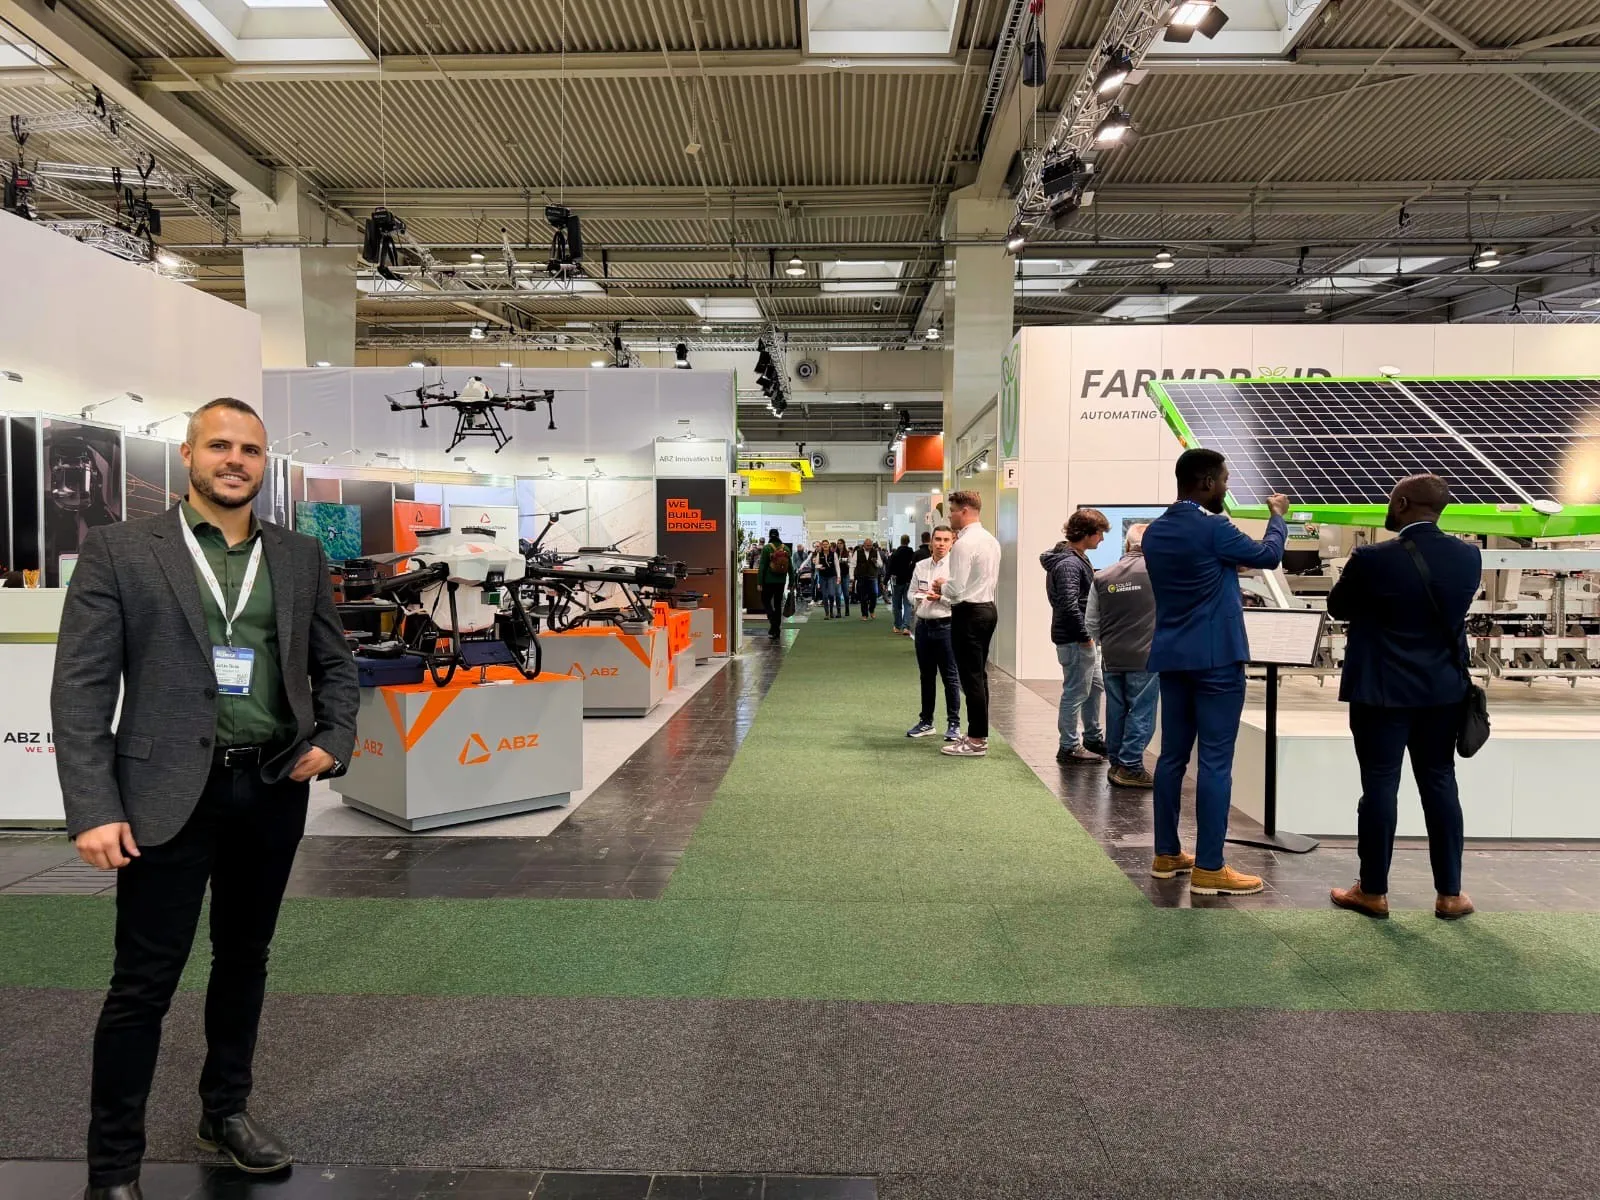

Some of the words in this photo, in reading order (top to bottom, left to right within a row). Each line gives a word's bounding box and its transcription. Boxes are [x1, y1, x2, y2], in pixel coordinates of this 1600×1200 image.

[1080, 410, 1157, 420] AUTOMATING
[659, 455, 674, 463] ABZ
[675, 455, 710, 463] Innovation
[1008, 468, 1015, 479] F
[732, 479, 738, 489] F
[741, 481, 747, 489] F
[668, 511, 698, 519] BUILD
[590, 667, 619, 677] ABZ
[3, 732, 41, 744] ABZ
[496, 733, 540, 752] ABZ
[363, 738, 384, 757] ABZ
